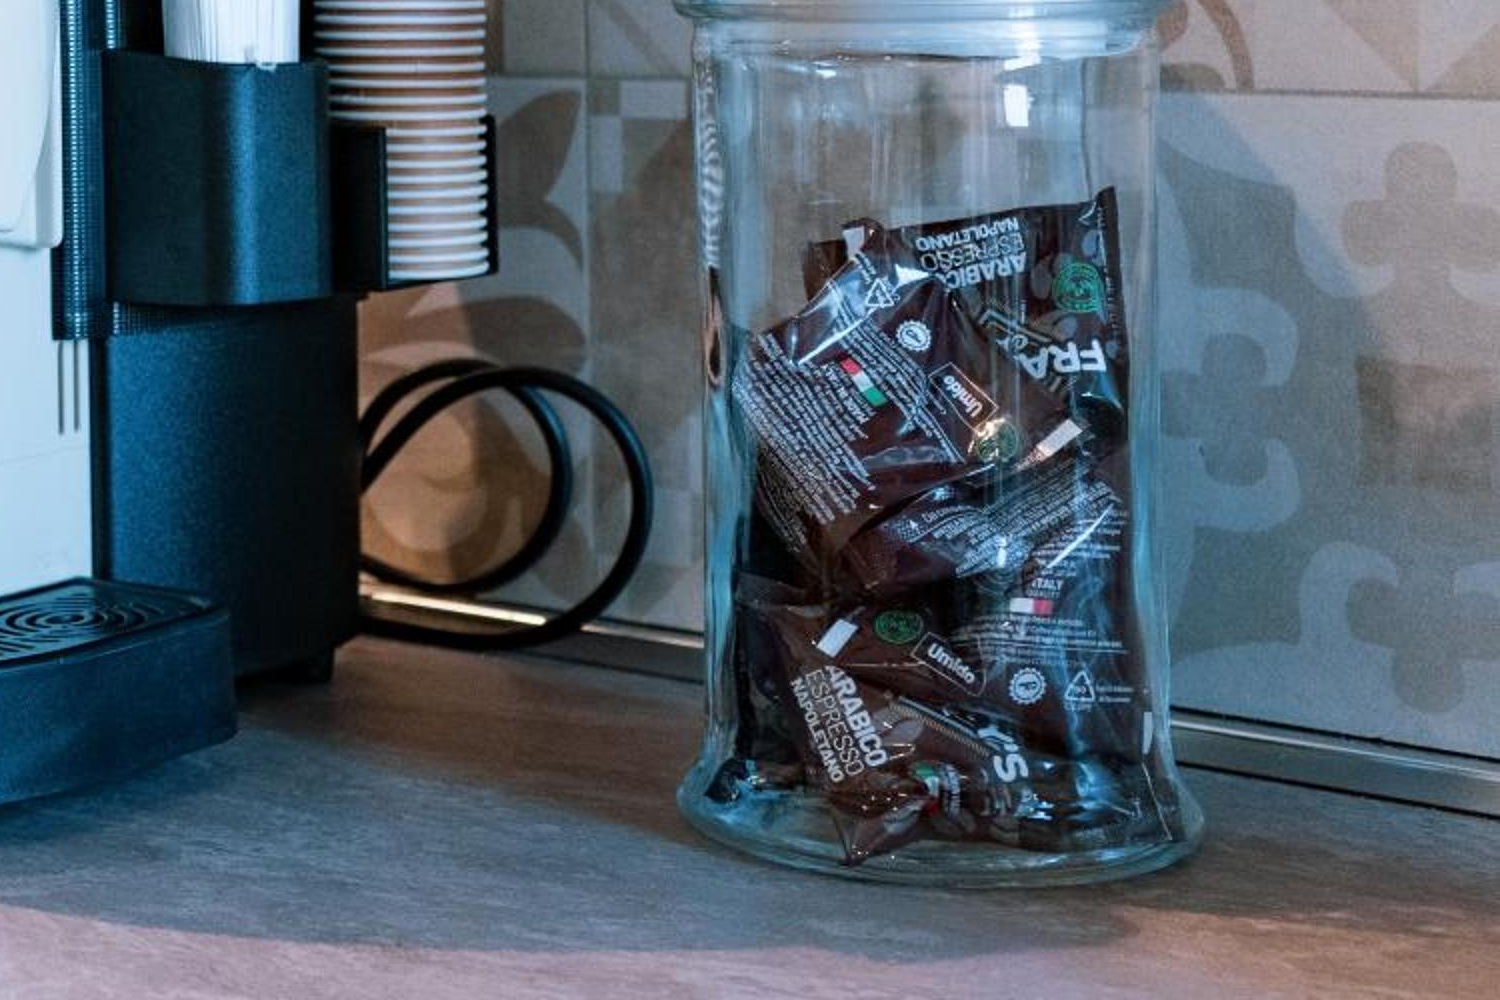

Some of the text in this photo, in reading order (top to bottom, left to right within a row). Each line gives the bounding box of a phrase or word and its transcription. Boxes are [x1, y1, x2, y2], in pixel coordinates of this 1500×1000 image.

[916, 216, 1019, 251] NAPOLETANO
[921, 232, 1025, 271] ESPRESSO
[943, 375, 983, 418] Umido
[927, 643, 976, 684] Umido
[790, 676, 845, 783] NAPOLETANO
[806, 669, 865, 775] ESPRESSO
[824, 665, 888, 767] ARABICO
